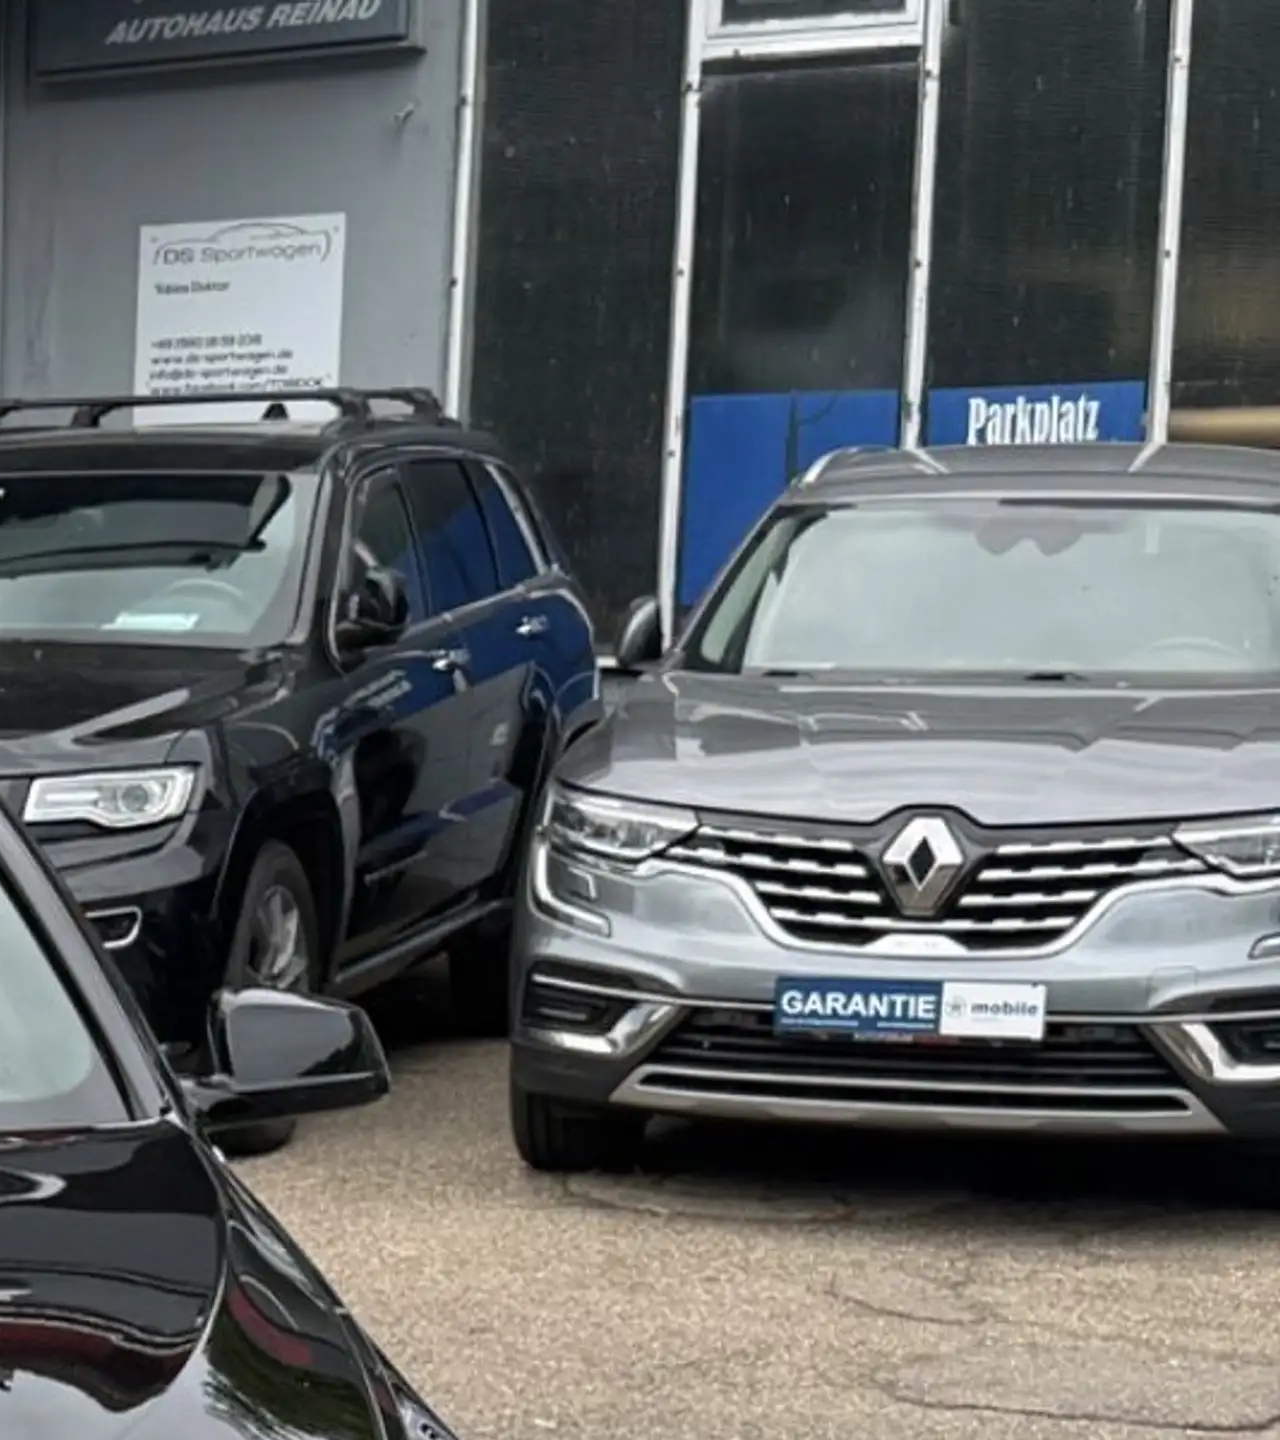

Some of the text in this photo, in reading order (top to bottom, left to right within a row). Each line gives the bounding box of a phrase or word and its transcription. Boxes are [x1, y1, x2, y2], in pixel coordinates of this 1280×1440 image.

[105, 6, 263, 45] AUTOHAUS
[200, 243, 323, 264] Sportwagen
[967, 392, 1101, 446] Parkplatz
[780, 991, 937, 1020] GARANTIE
